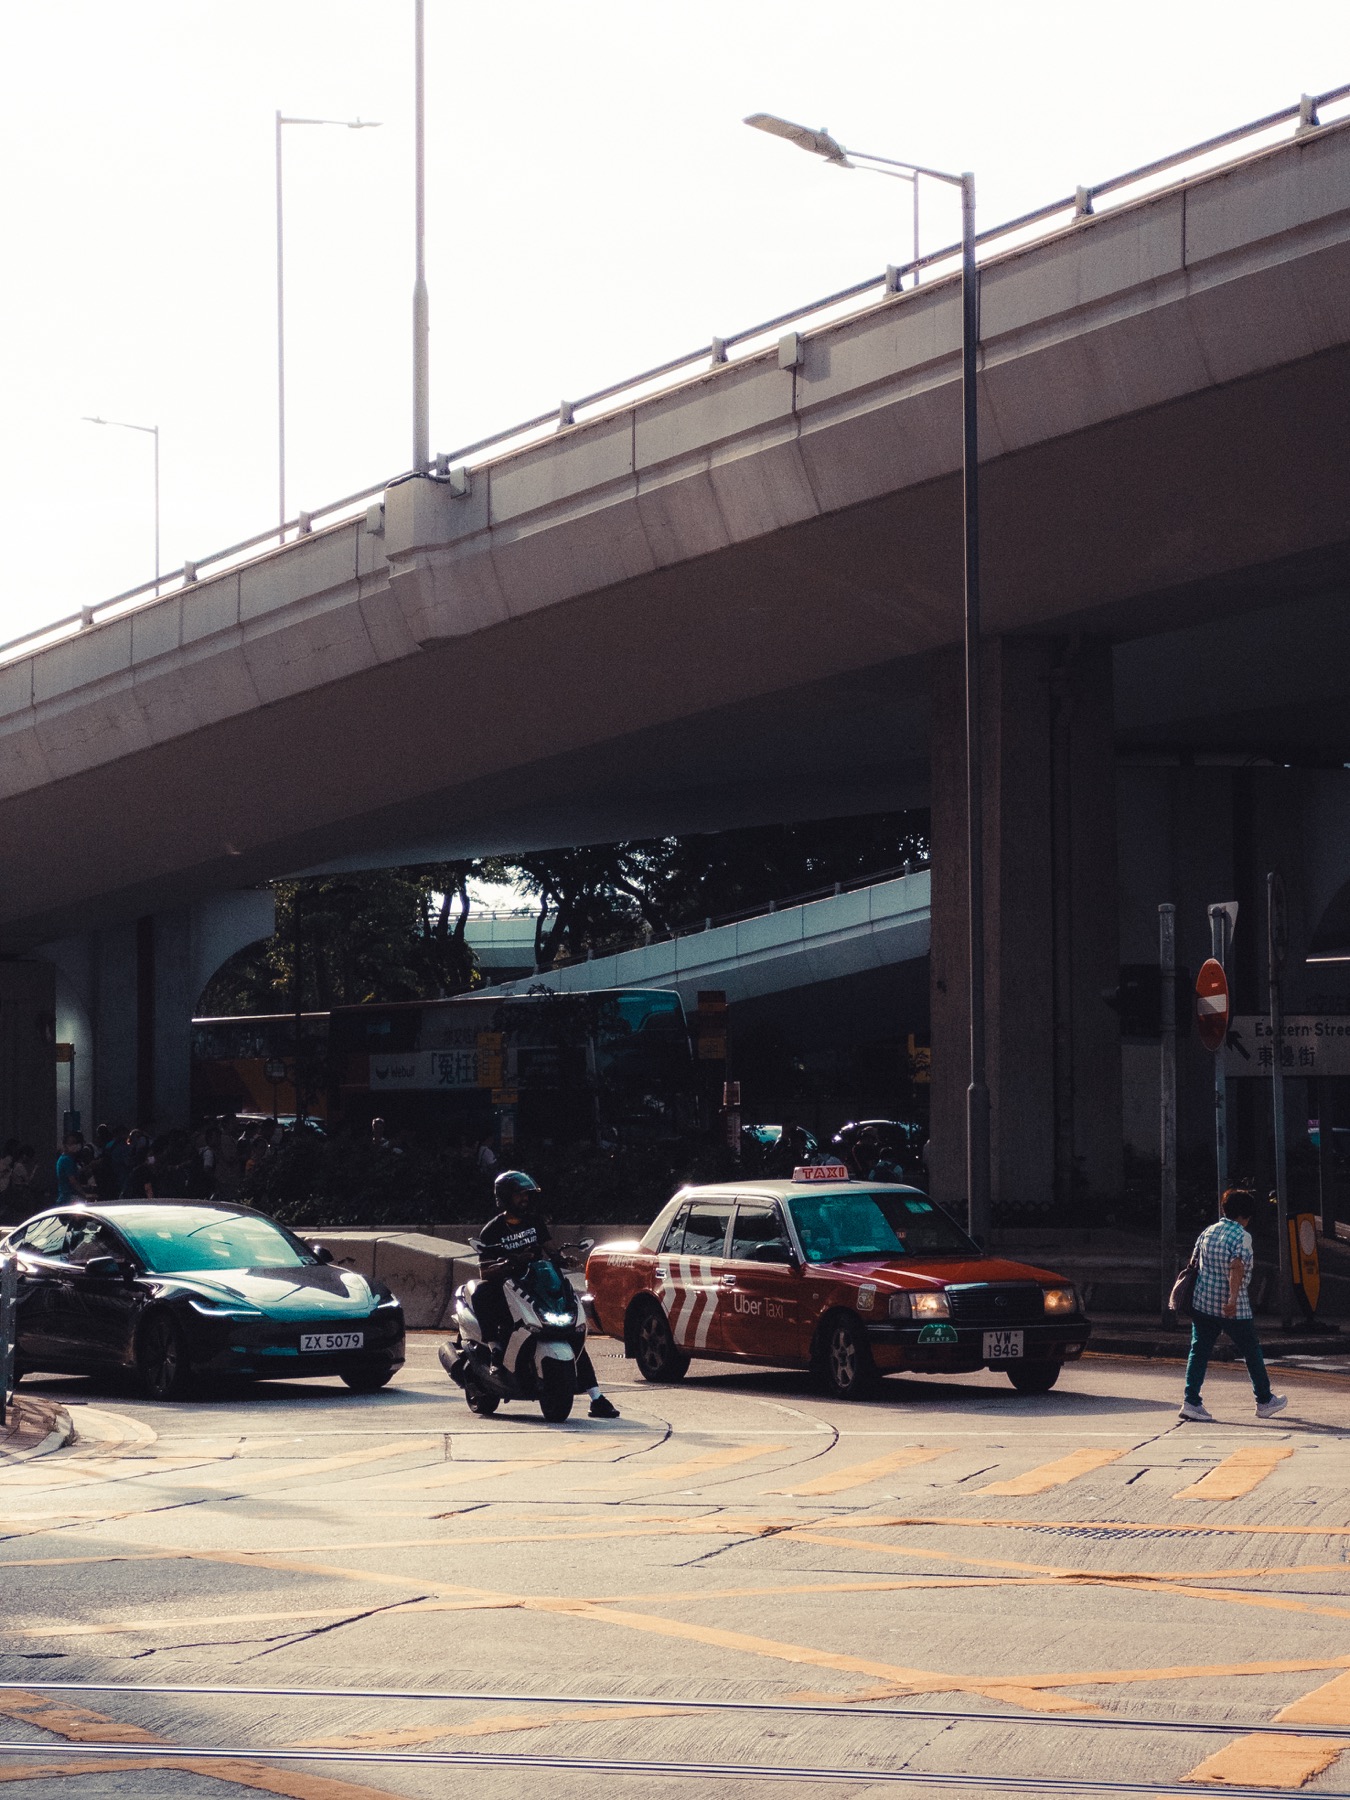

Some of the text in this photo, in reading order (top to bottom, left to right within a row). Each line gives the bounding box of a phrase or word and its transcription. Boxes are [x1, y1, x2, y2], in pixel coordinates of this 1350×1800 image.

[1255, 1022, 1310, 1037] Eatern
[802, 1167, 845, 1180] TAXI
[733, 1293, 784, 1319] Uber Taxi
[934, 1327, 943, 1337] 4
[995, 1331, 1012, 1344] VW
[304, 1334, 360, 1349] ZX 5079
[988, 1343, 1019, 1357] 1946
